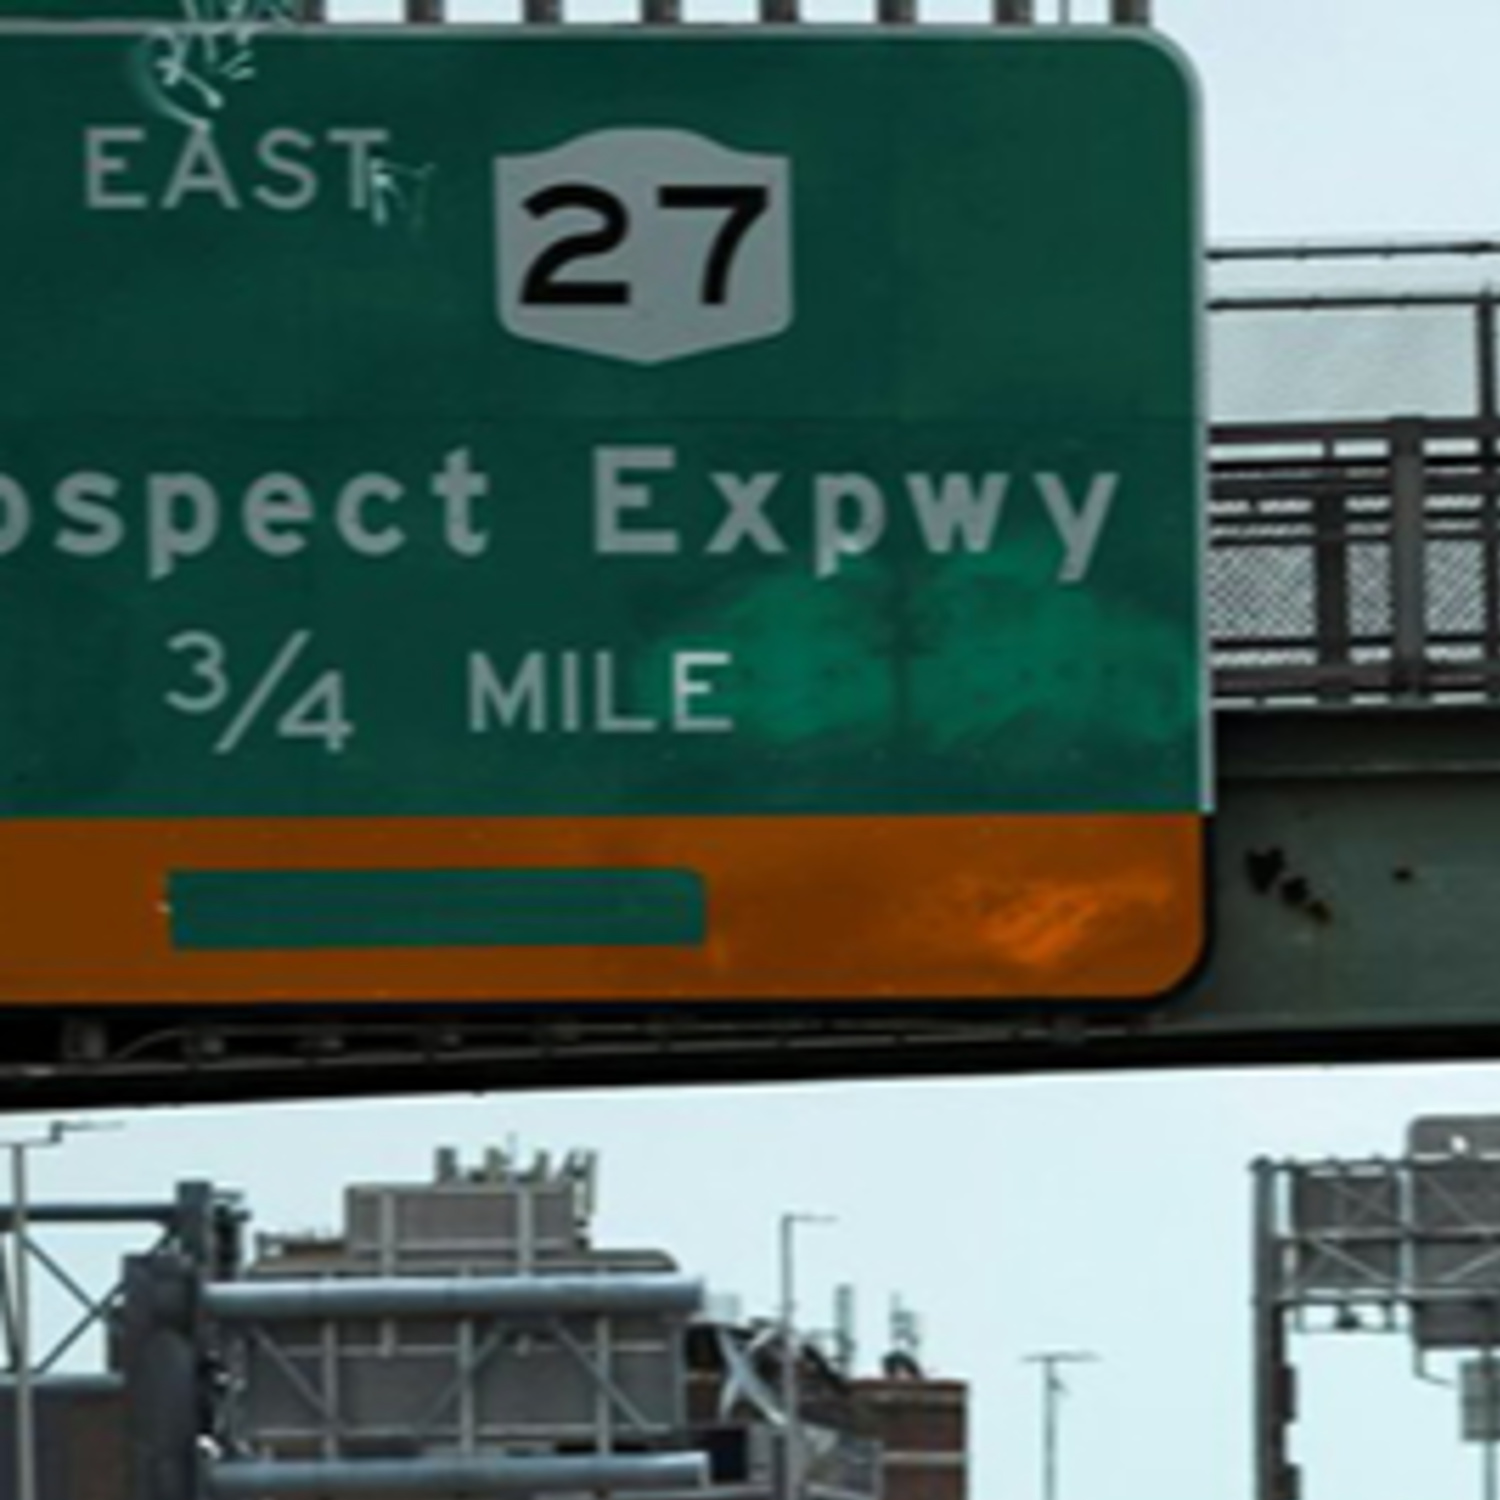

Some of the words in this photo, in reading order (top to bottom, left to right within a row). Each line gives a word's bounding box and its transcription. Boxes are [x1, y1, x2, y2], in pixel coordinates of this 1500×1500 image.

[84, 125, 394, 211] EAST
[519, 183, 769, 307] 27
[593, 446, 1118, 583] Expwy
[469, 649, 734, 733] MILE
